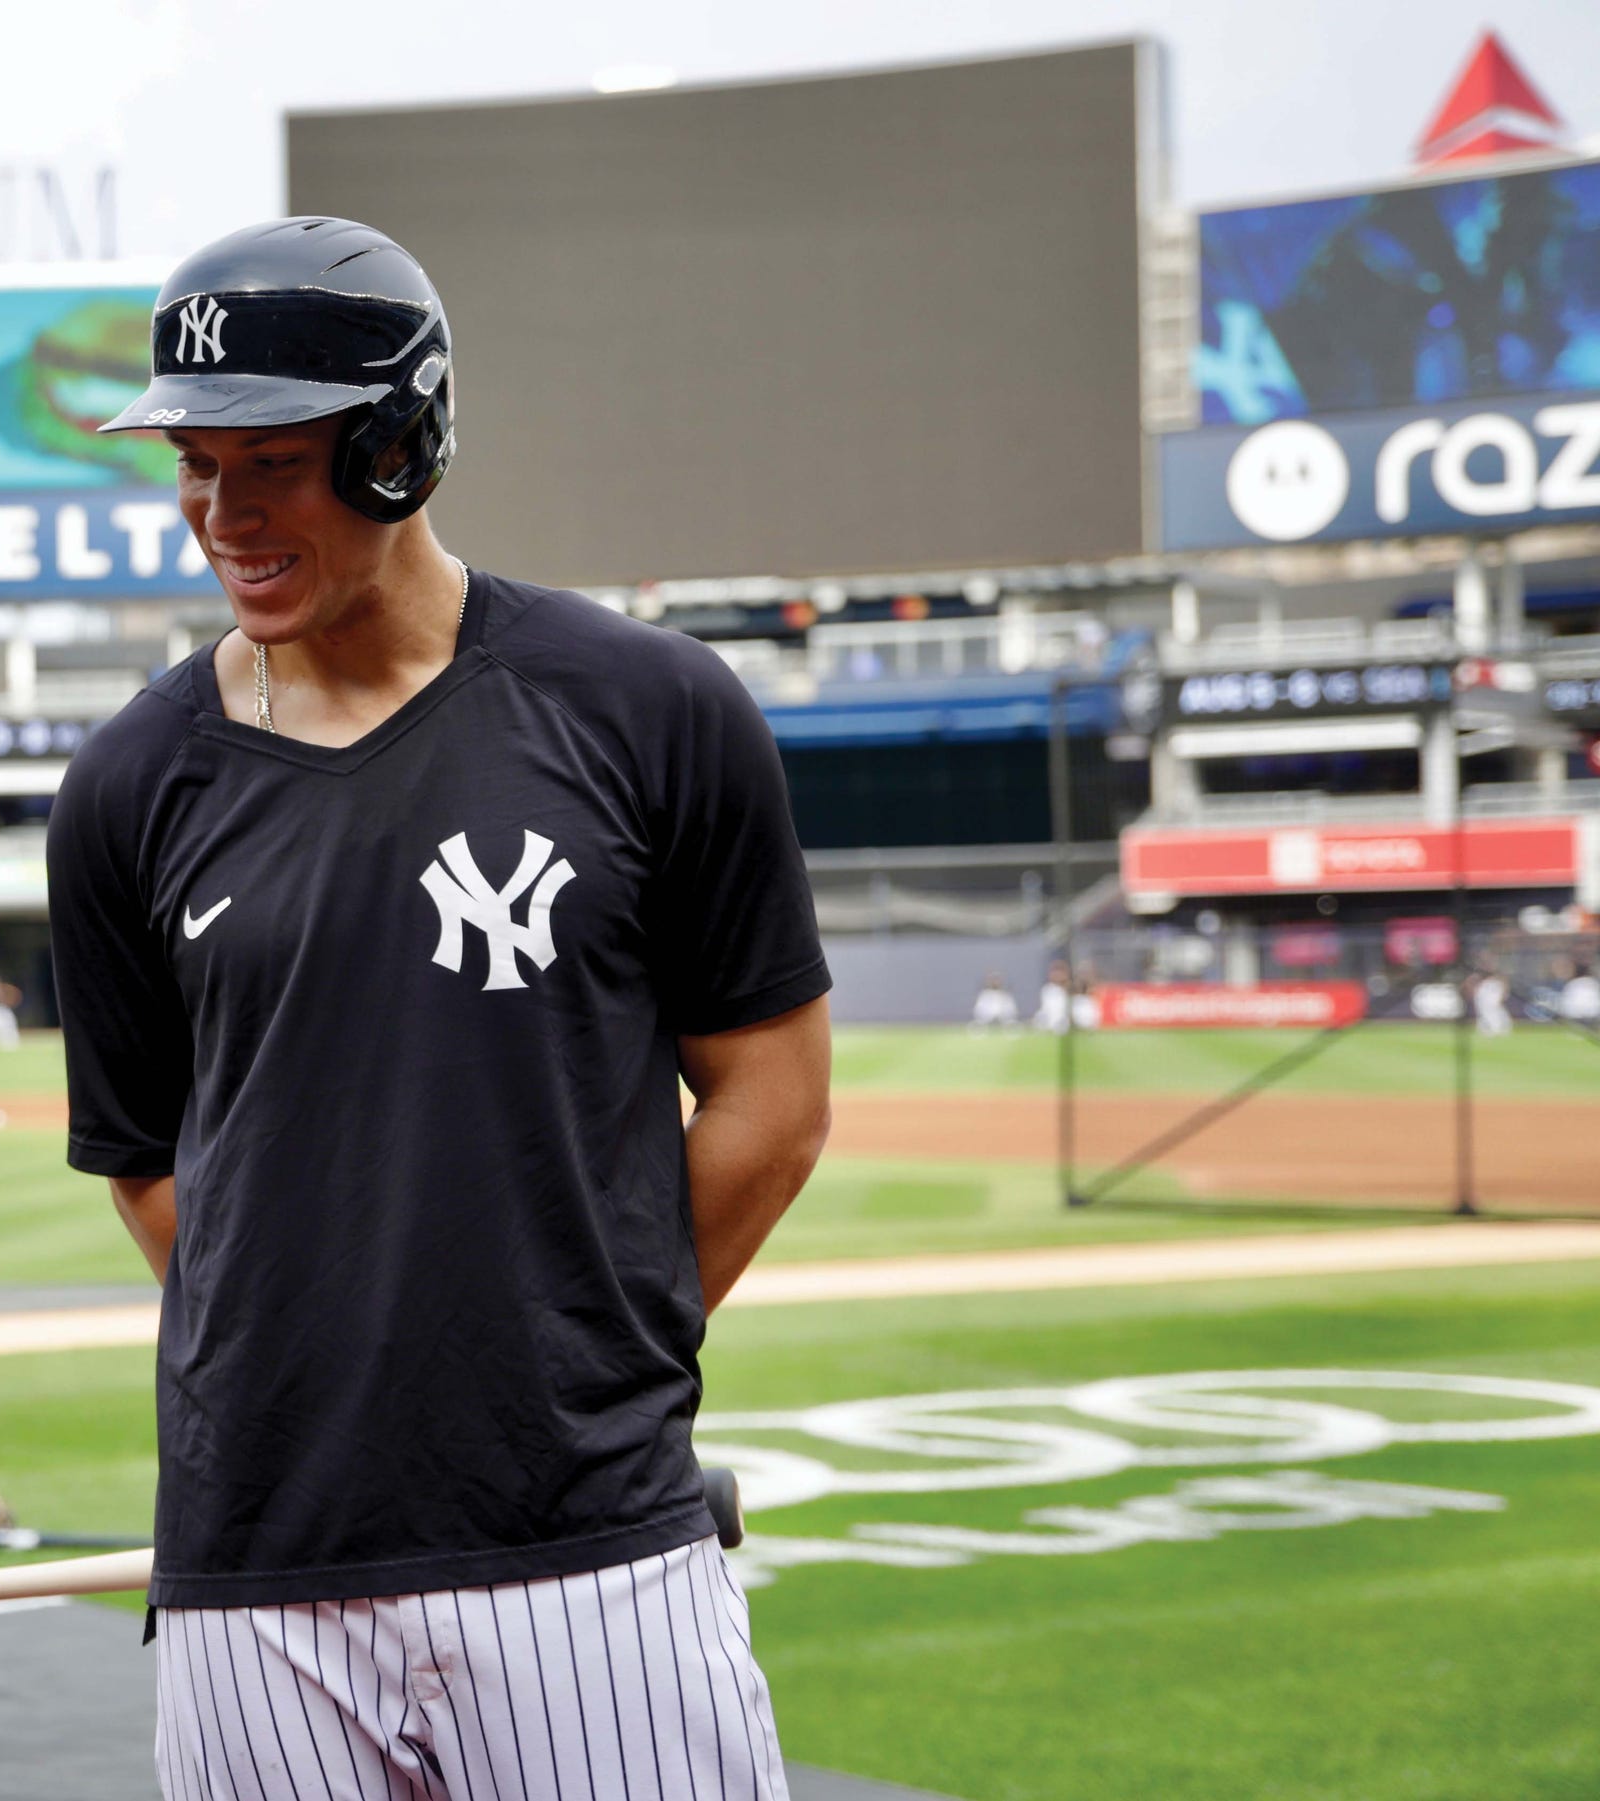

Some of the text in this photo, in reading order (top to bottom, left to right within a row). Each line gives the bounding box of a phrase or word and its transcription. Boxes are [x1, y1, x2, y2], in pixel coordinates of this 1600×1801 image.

[175, 292, 229, 364] NY
[143, 408, 187, 425] 99
[418, 829, 578, 991] NY
